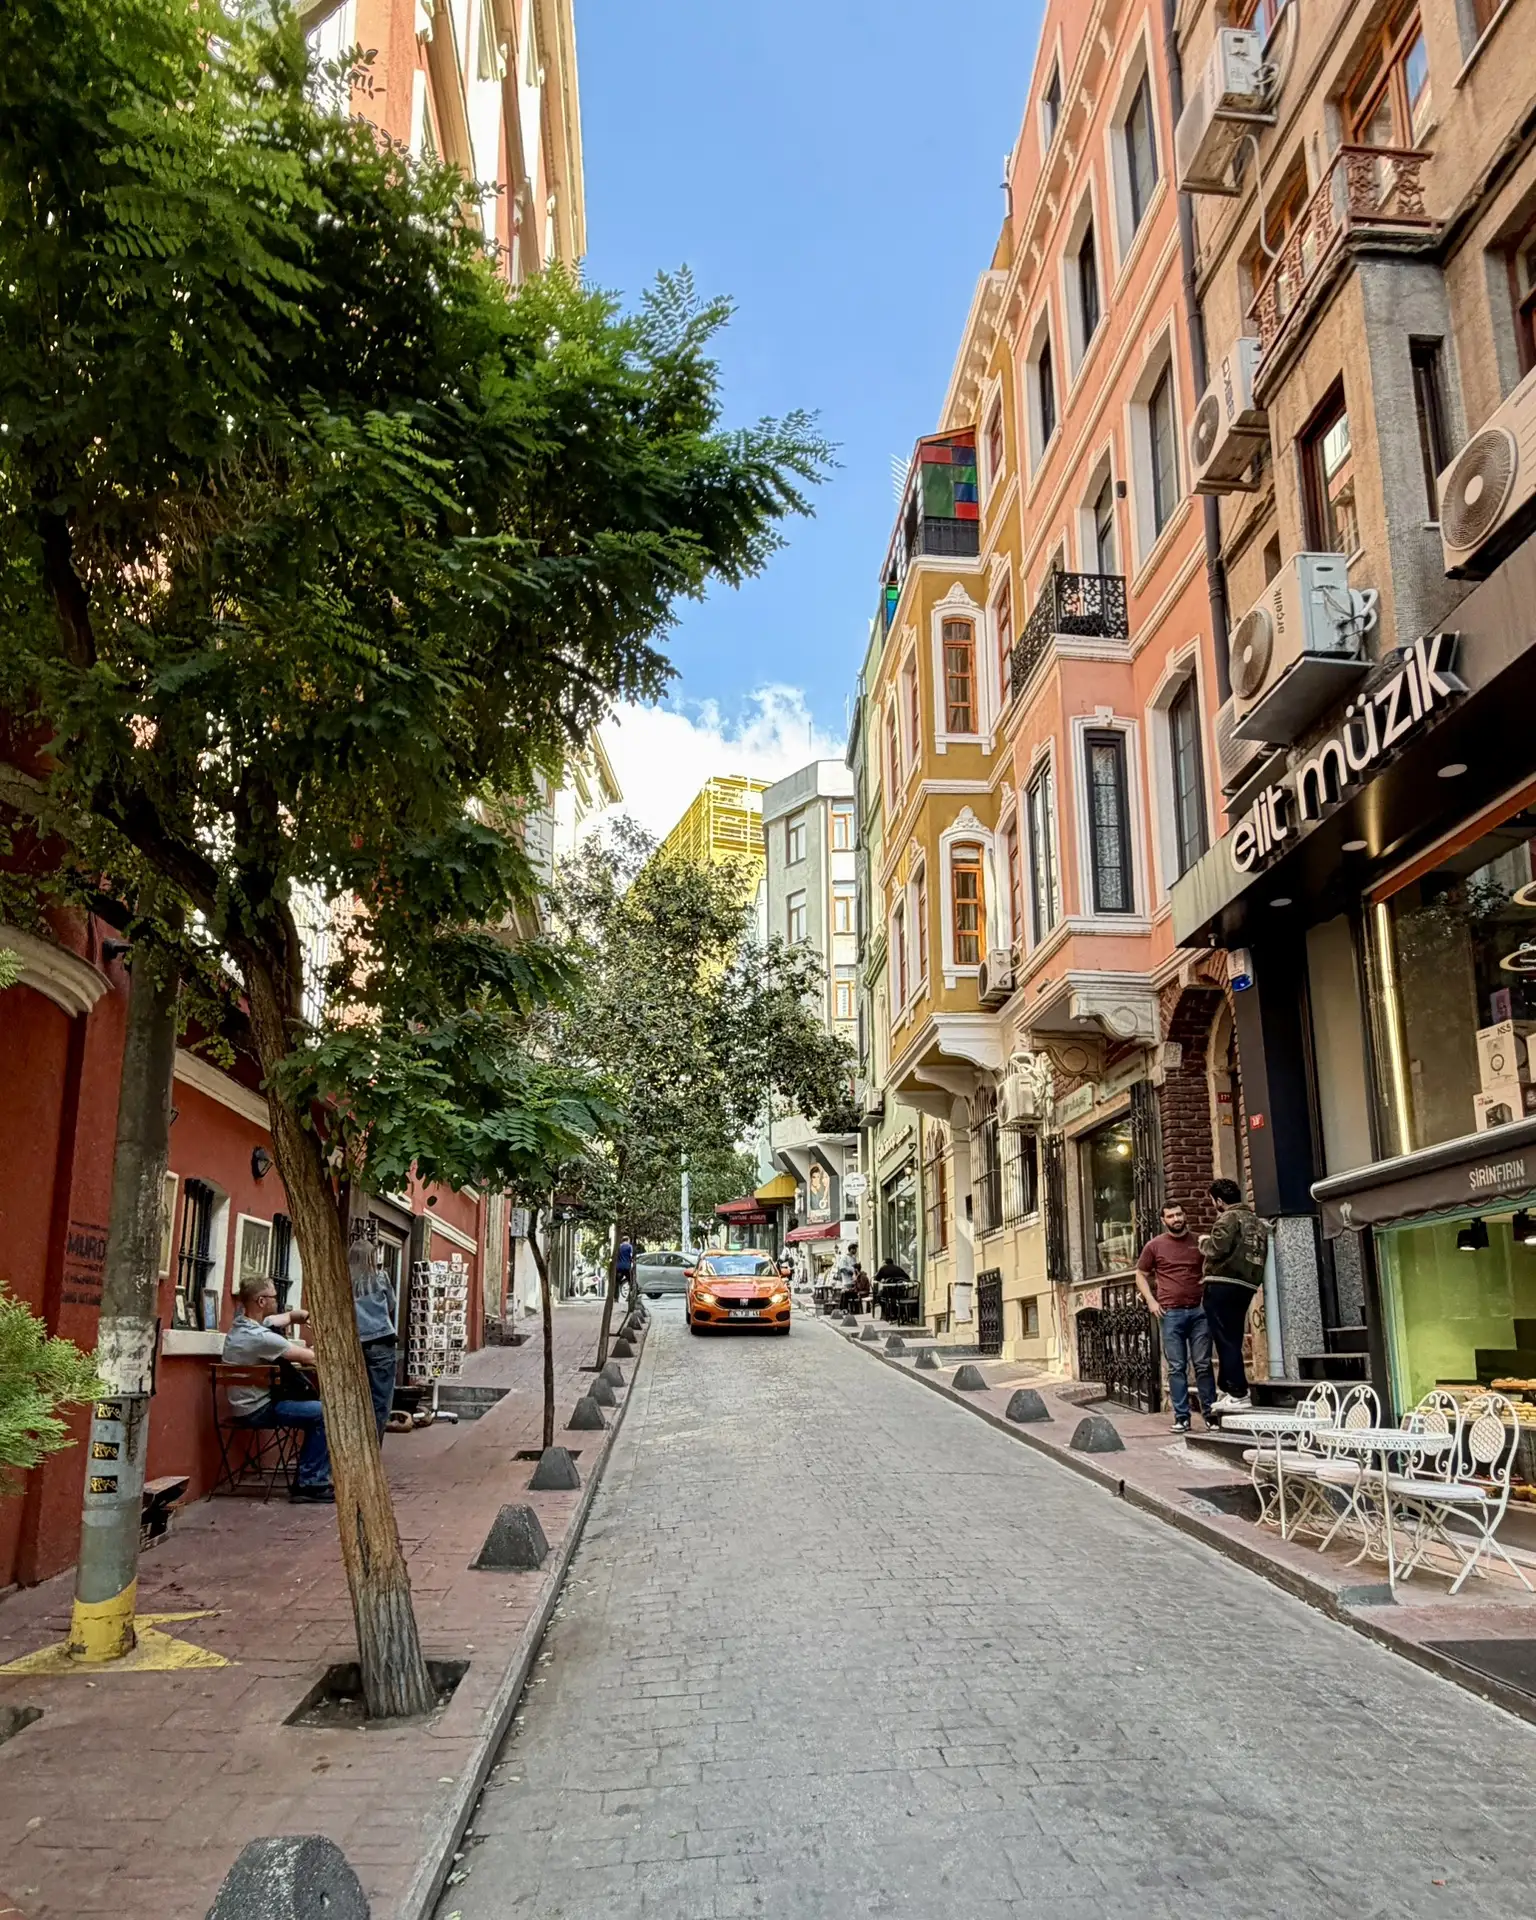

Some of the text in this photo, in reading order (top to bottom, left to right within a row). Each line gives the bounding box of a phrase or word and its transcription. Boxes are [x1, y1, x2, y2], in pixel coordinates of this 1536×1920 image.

[1273, 587, 1286, 635] arçelik
[1230, 632, 1458, 873] elit müzik
